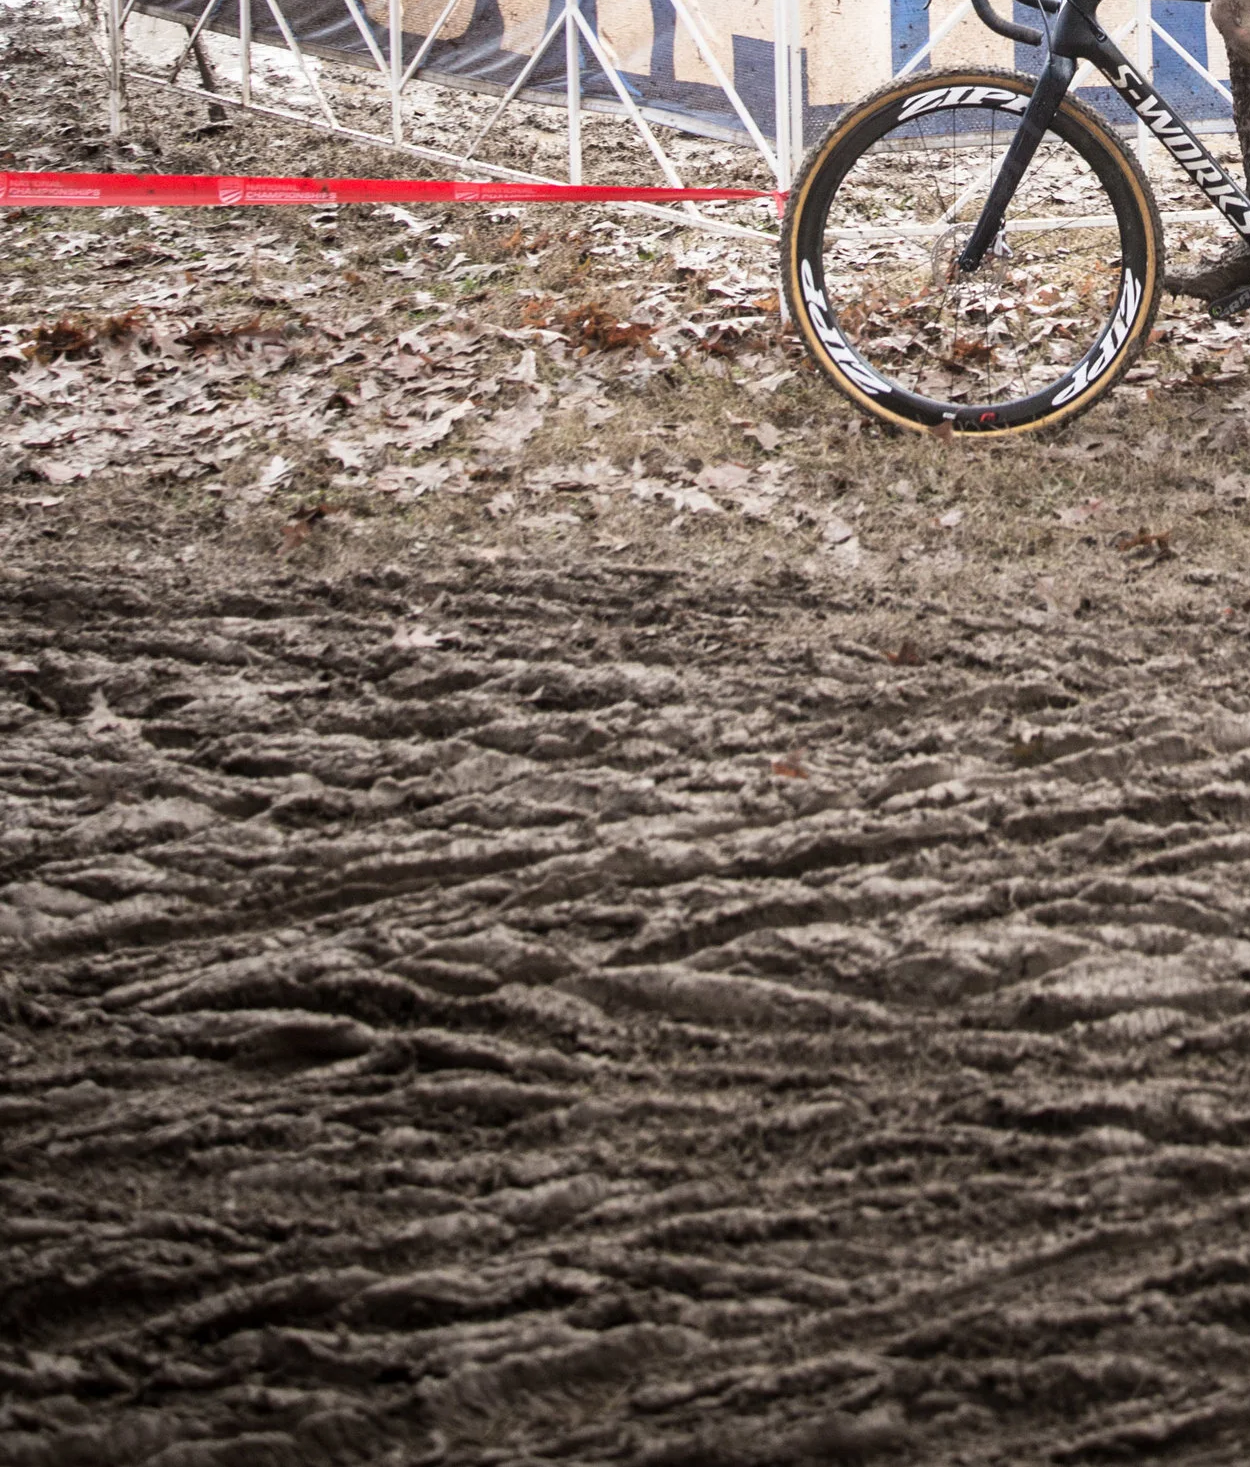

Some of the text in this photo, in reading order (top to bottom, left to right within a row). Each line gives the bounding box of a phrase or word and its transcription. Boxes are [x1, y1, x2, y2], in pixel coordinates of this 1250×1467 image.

[245, 191, 337, 200] CHAMPIONSHIPS
[800, 259, 892, 395] ZIPP
[1051, 267, 1142, 406] ZIPP
